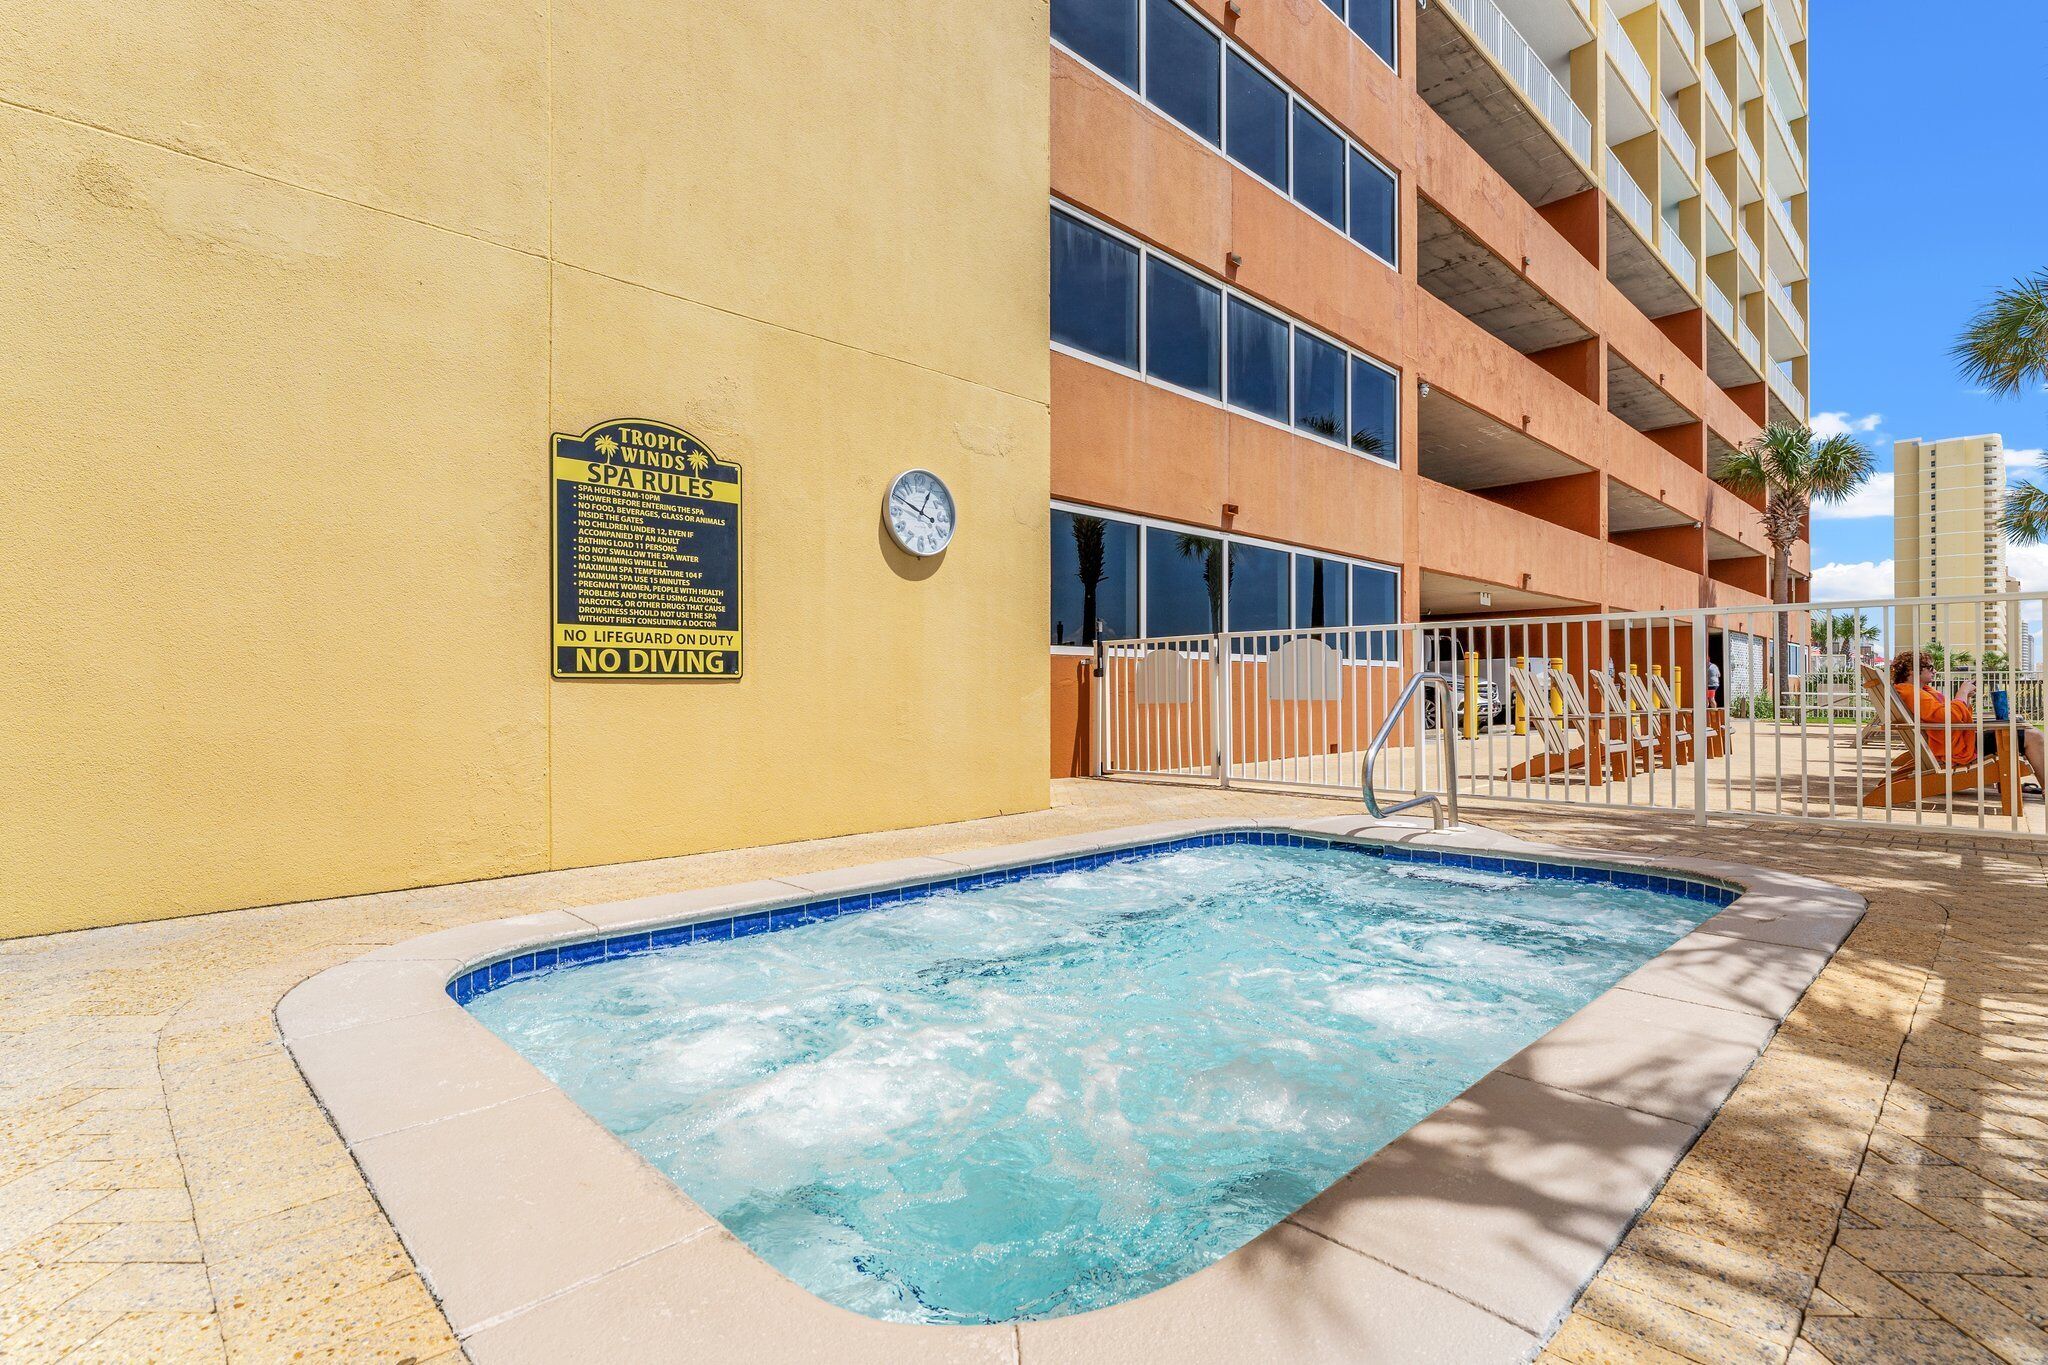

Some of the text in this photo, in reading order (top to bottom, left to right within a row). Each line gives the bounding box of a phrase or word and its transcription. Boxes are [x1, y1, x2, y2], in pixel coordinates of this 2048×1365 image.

[618, 427, 687, 453] TROPIC
[620, 446, 686, 471] WINDS
[587, 463, 713, 498] SPA RULES
[594, 487, 620, 496] HOURS
[622, 490, 660, 501] 8AM-10PM
[578, 494, 704, 516] SHOWER BEFORE ENTERING THE SPA
[579, 511, 604, 519] INSIDE
[621, 516, 643, 524] GATES
[592, 504, 615, 513] FOOD,
[617, 507, 660, 518] BEVERAGES,
[662, 513, 683, 521] GLASS
[696, 517, 725, 526] ANIMALS
[592, 521, 629, 531] CHILDREN
[631, 525, 655, 534] UNDER
[936, 525, 947, 538] 4
[579, 528, 679, 545] ACCOMPANIED BY AN ADULT
[905, 530, 914, 544] 7
[917, 535, 924, 552] 6
[927, 533, 937, 550] 5
[579, 537, 612, 546] BATHING
[614, 540, 634, 548] LOAD
[645, 543, 677, 552] PERSONS
[592, 556, 632, 565] SWIMMING
[634, 559, 656, 567] WHILE
[609, 549, 647, 558] SWALLOW
[676, 555, 699, 563] WATER
[579, 563, 617, 572] MAXIMUM
[619, 566, 633, 574] SPA
[634, 568, 683, 578] TEMPERATURE
[579, 572, 617, 581] MAXIMUM
[660, 578, 690, 586] MINUTES
[579, 580, 619, 589] PREGNANT
[621, 583, 651, 592] WOMEN,
[680, 587, 697, 595] WITH
[579, 589, 619, 598] PROBLEMS
[690, 596, 722, 604] ALCOHOL,
[579, 598, 623, 607] NARCOTICS,
[579, 607, 628, 615] DROWSINESS
[630, 609, 659, 617] SHOULD
[579, 615, 615, 623] WITHOUT
[638, 618, 681, 626] CONSULTING
[564, 630, 733, 646] NO LIFEGUARD ON DUTY
[576, 648, 723, 672] NO DIVING
